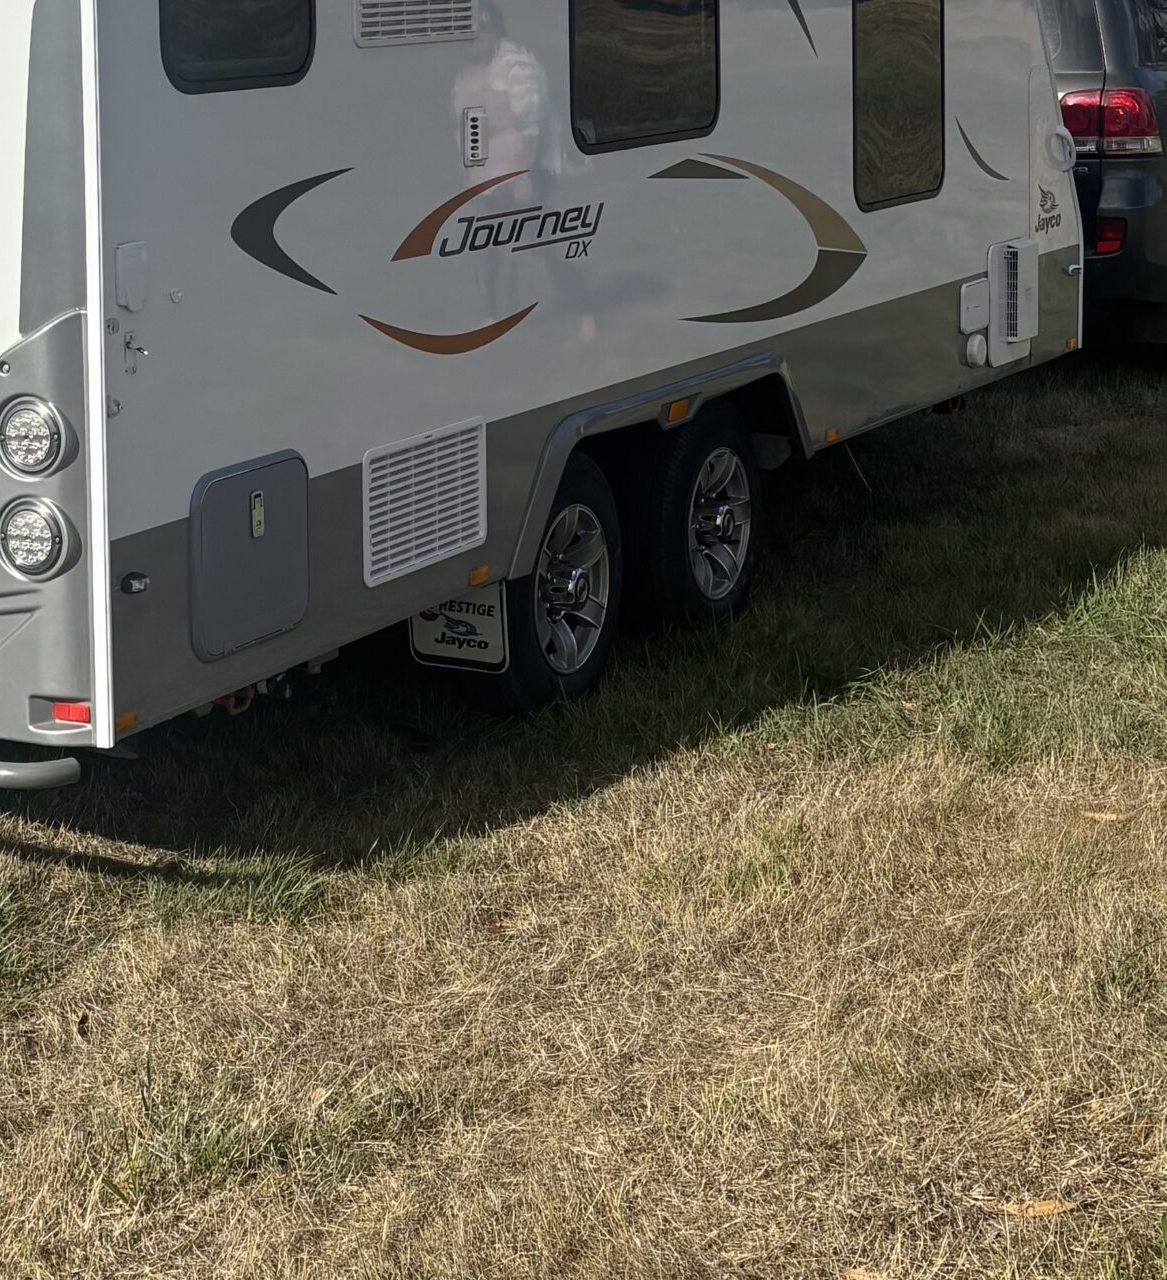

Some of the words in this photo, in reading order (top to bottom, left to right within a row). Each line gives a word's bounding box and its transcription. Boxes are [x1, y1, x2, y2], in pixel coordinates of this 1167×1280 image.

[438, 201, 605, 258] Journey
[1034, 213, 1062, 235] Jayco
[564, 239, 593, 260] DX
[438, 599, 496, 617] RESTIGE
[434, 631, 489, 650] Jayco
